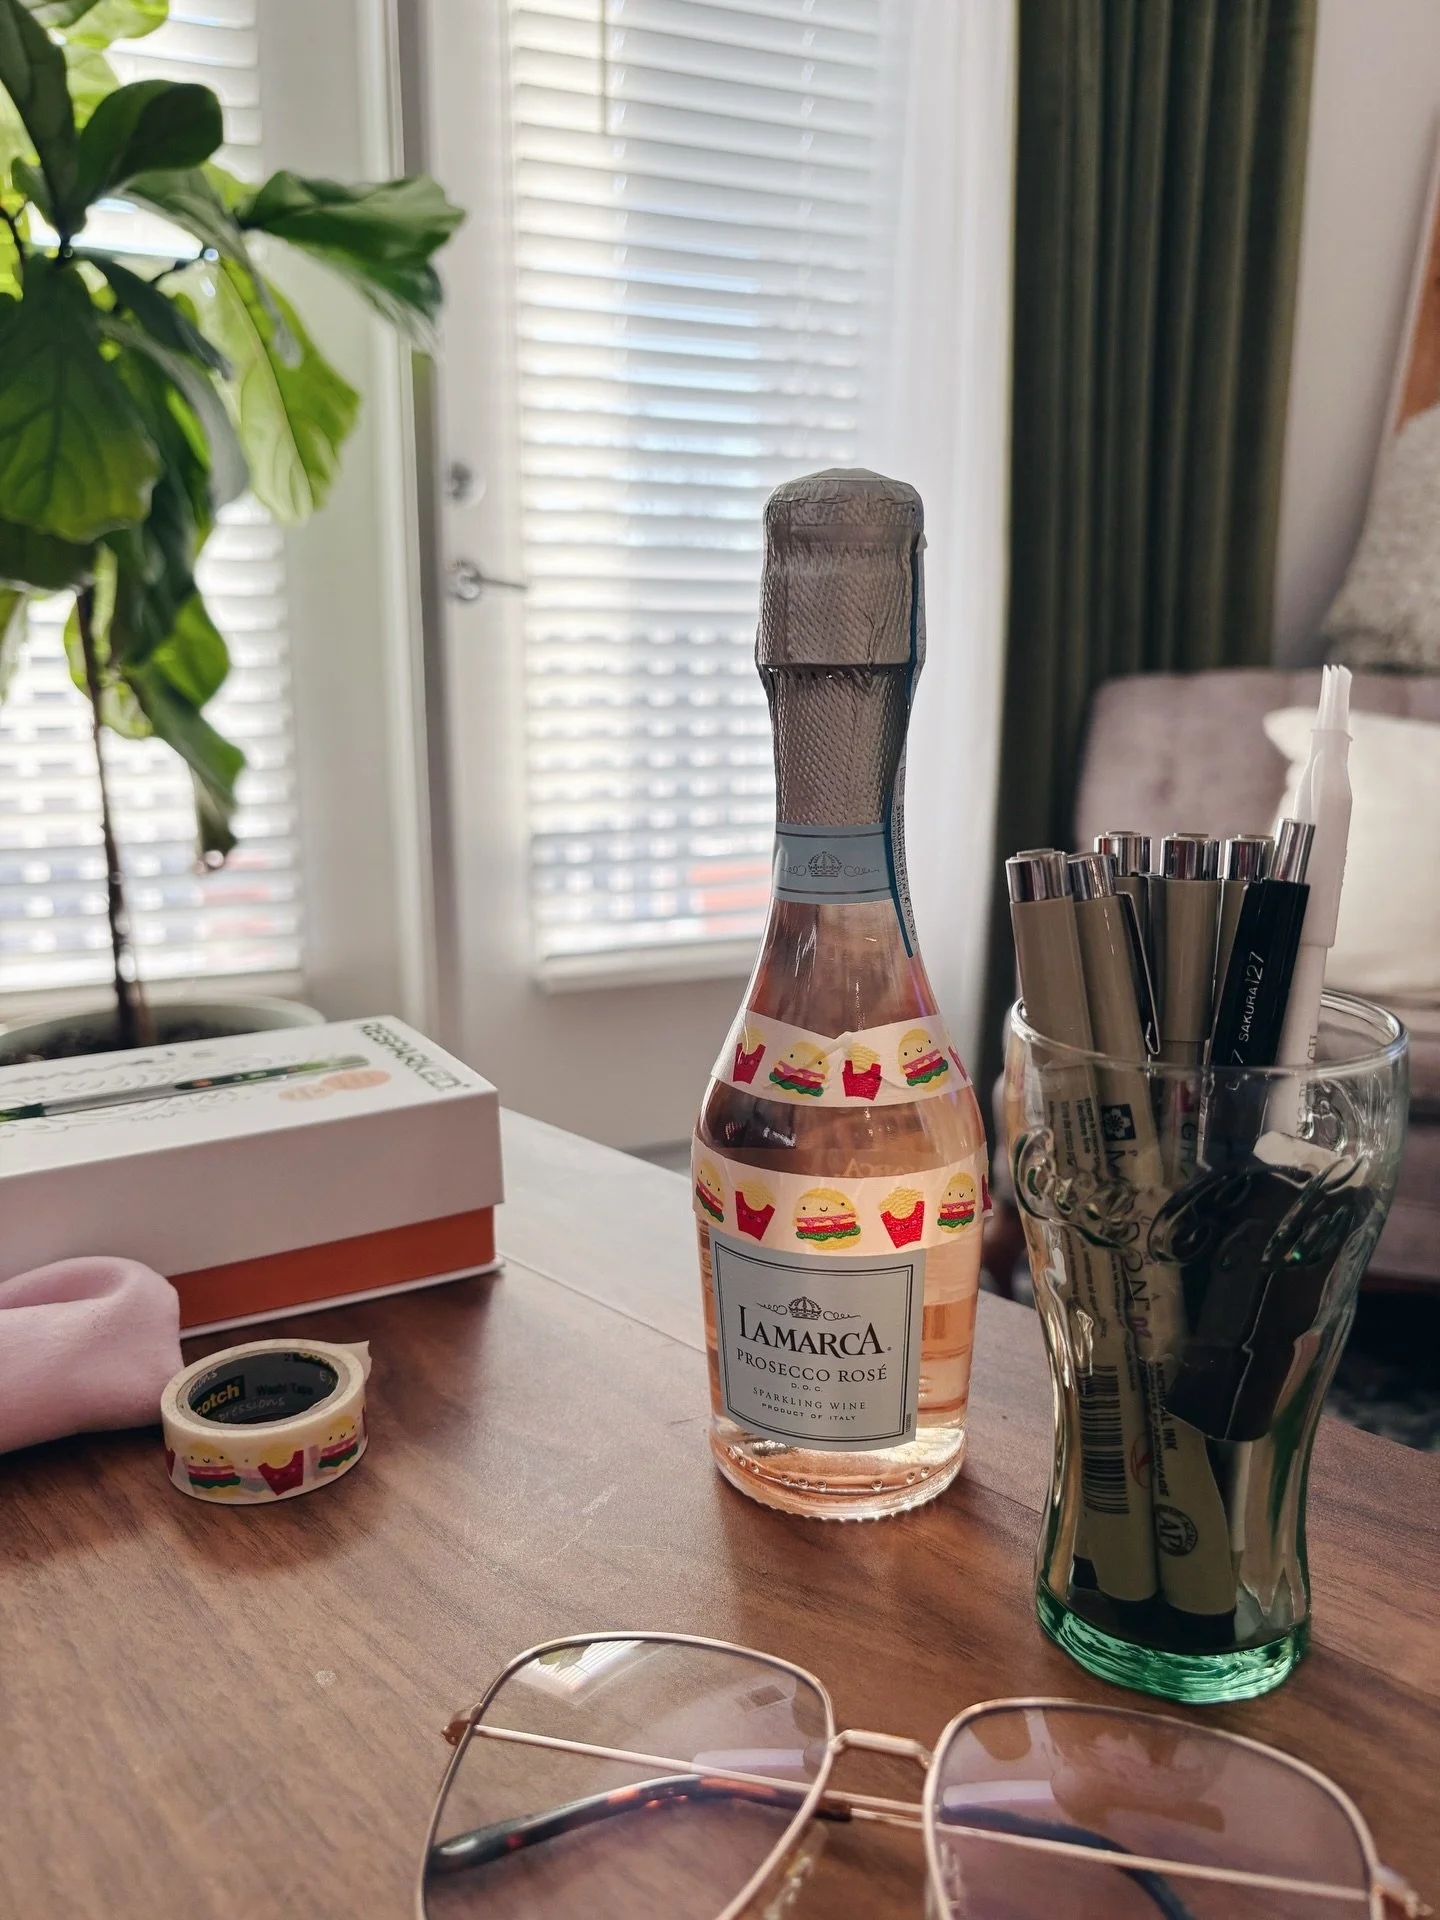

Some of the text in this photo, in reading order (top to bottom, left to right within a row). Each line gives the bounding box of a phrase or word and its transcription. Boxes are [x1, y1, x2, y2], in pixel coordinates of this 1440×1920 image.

[1238, 986, 1258, 1042] SAKURA
[737, 1304, 885, 1359] LAMARCA
[736, 1347, 887, 1383] PROSECCO ROSÉ
[195, 1383, 240, 1416] cotch
[753, 1387, 866, 1410] SPARKLING WINE
[762, 1402, 805, 1417] PRODUCT
[1163, 1427, 1178, 1451] INK
